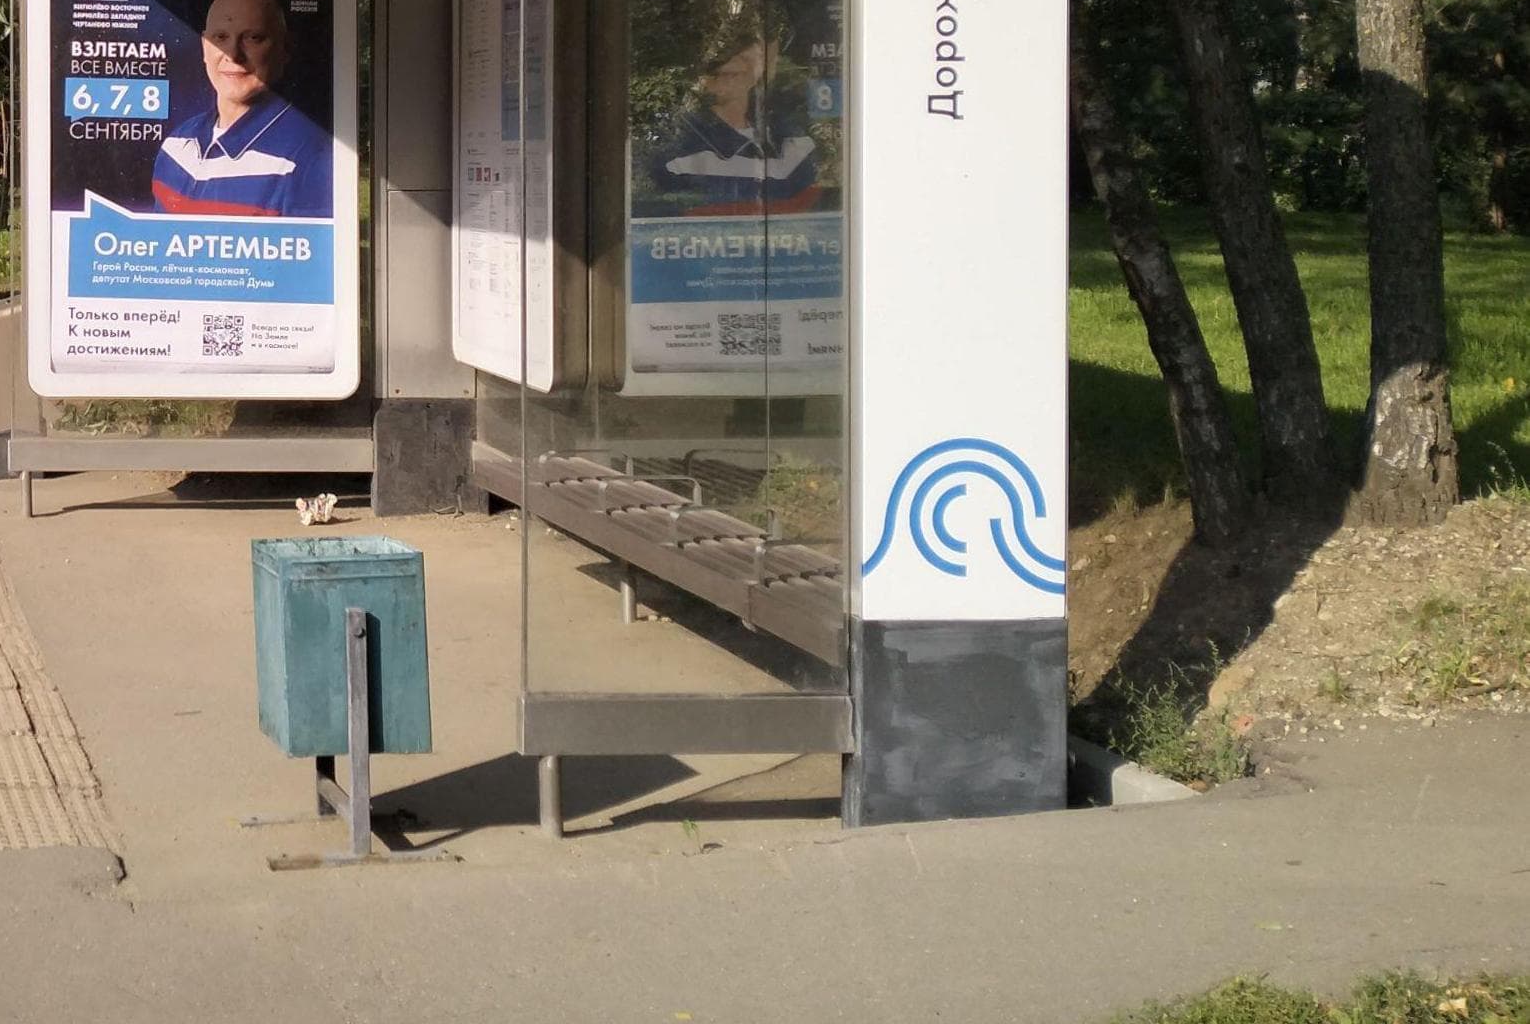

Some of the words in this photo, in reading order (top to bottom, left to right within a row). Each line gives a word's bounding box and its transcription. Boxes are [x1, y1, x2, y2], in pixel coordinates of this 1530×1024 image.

[71, 41, 167, 59] ВЗЛЕТАЕМ
[71, 59, 100, 74] ВСЕ
[105, 60, 167, 76] ВМЕСТЕ
[73, 84, 99, 114] 6,
[110, 85, 132, 115] 7,
[142, 85, 160, 112] 8
[69, 121, 163, 141] СЕНТЯБРЯ
[94, 232, 158, 256] Олег
[165, 234, 312, 261] АРТЕМЬЕВ
[92, 261, 121, 273] Герой
[124, 262, 160, 274] России,
[162, 263, 251, 275] лётчик-космонавт,
[92, 275, 130, 285] депутат
[132, 275, 192, 286] Московской
[194, 277, 245, 288] городской
[246, 277, 275, 289] Думы
[68, 307, 119, 321] Только
[123, 310, 181, 325] вперёд!
[68, 324, 78, 337] К
[83, 328, 132, 338] новым
[66, 344, 171, 356] достижениям!
